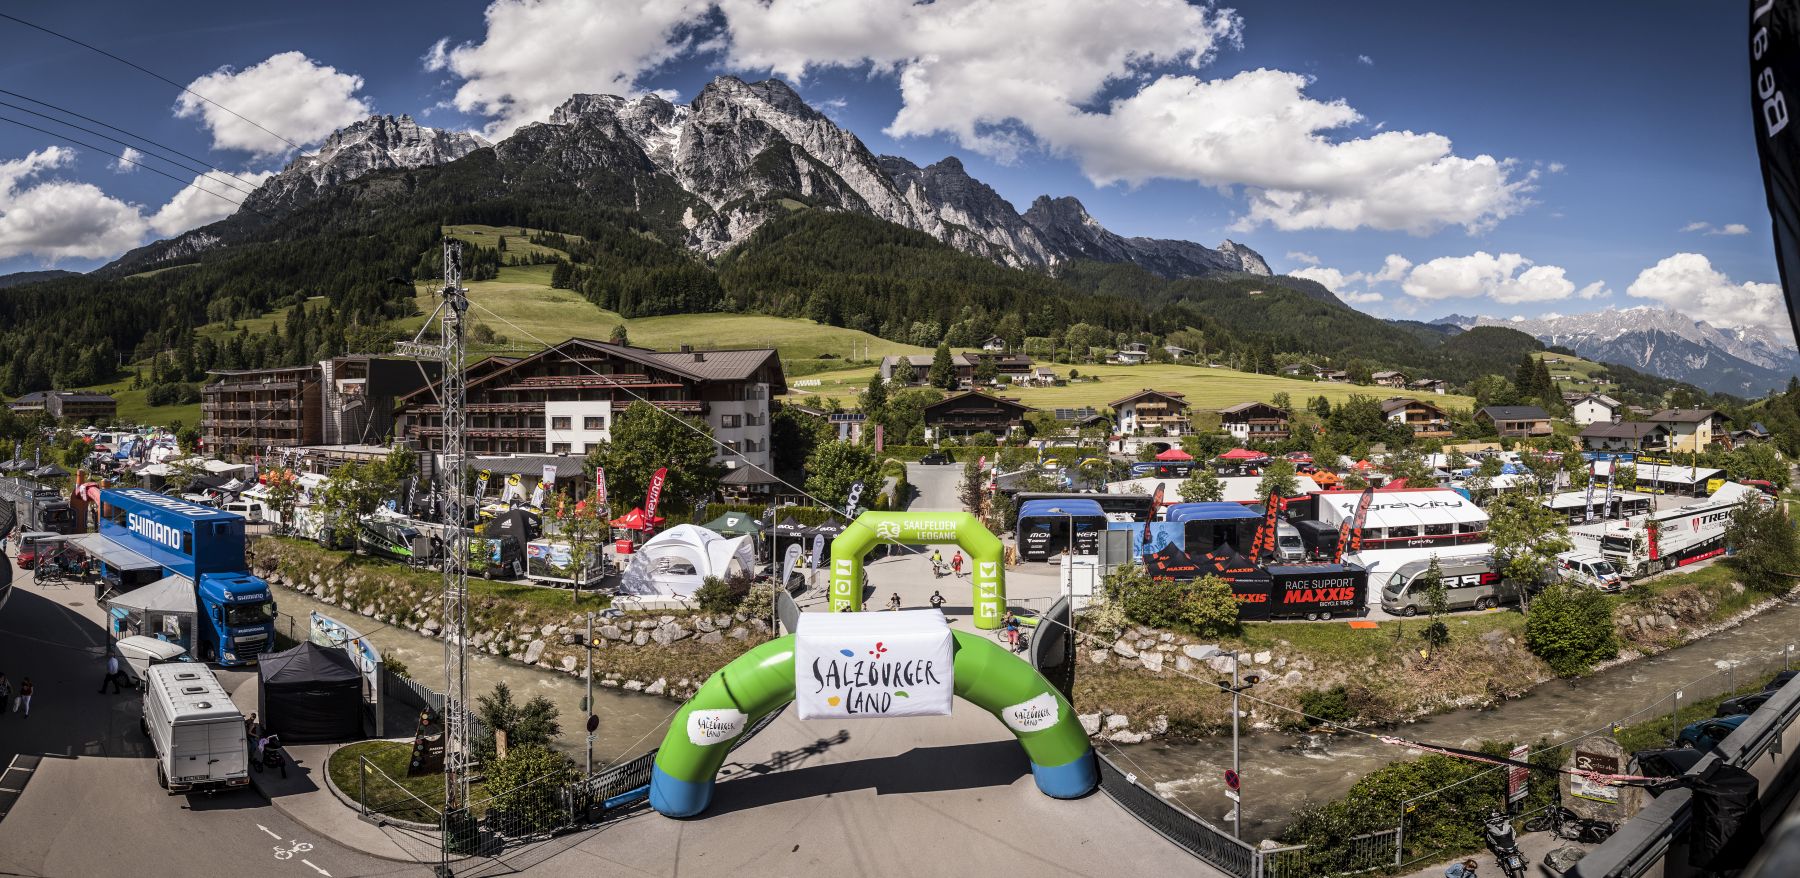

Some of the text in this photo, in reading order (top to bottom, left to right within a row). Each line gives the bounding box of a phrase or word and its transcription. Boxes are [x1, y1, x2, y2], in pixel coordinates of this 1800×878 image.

[1263, 492, 1279, 552] MAXXIS
[1700, 510, 1732, 524] TREK
[128, 512, 180, 550] SHIMANO
[903, 520, 957, 531] SAALFELDEN
[917, 531, 957, 540] LEOGANG
[1285, 577, 1355, 590] RACE SUPPORT
[1283, 587, 1356, 604] MAXXIS
[812, 656, 941, 694] SALZBURGER
[845, 686, 892, 715] LAND
[1014, 707, 1051, 721] SALZBURGER
